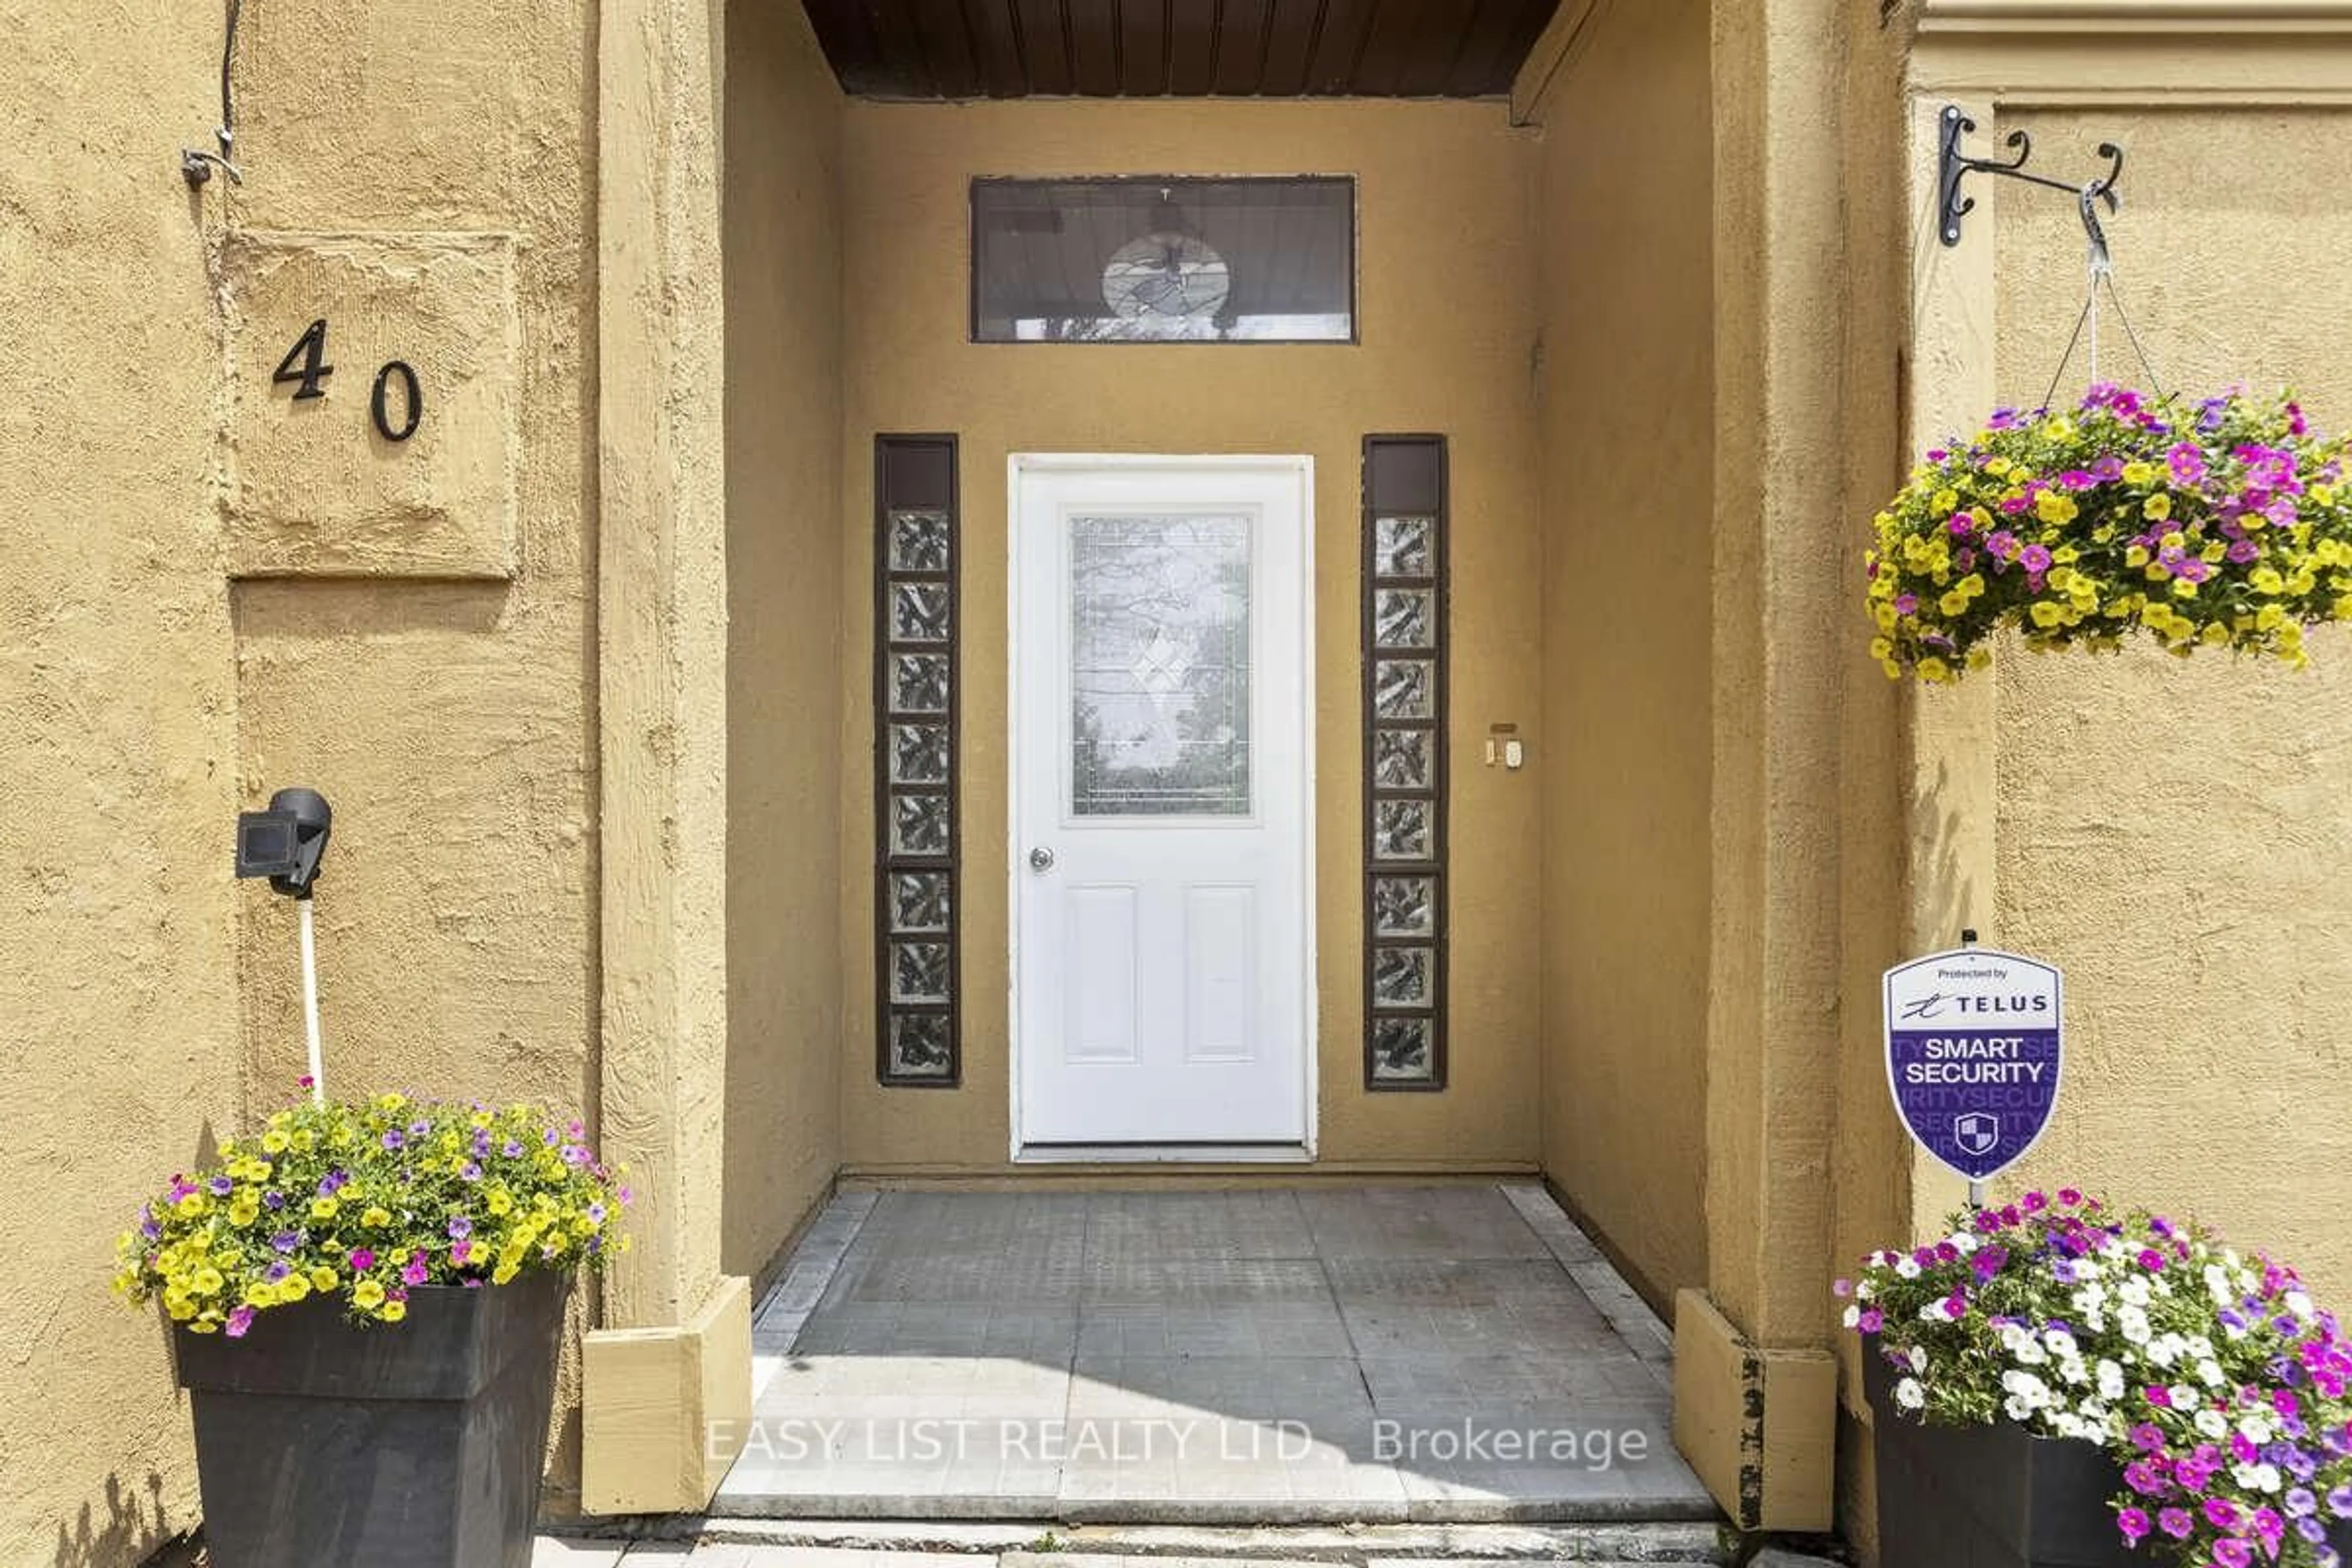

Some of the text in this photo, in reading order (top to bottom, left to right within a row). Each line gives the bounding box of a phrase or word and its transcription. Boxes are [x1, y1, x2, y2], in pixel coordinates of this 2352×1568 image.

[273, 319, 422, 442] 40
[1938, 968, 2007, 980] Protected by
[1957, 995, 2047, 1012] TELUS
[1926, 1038, 2024, 1059] SMART
[1906, 1063, 2045, 1084] SECURITY
